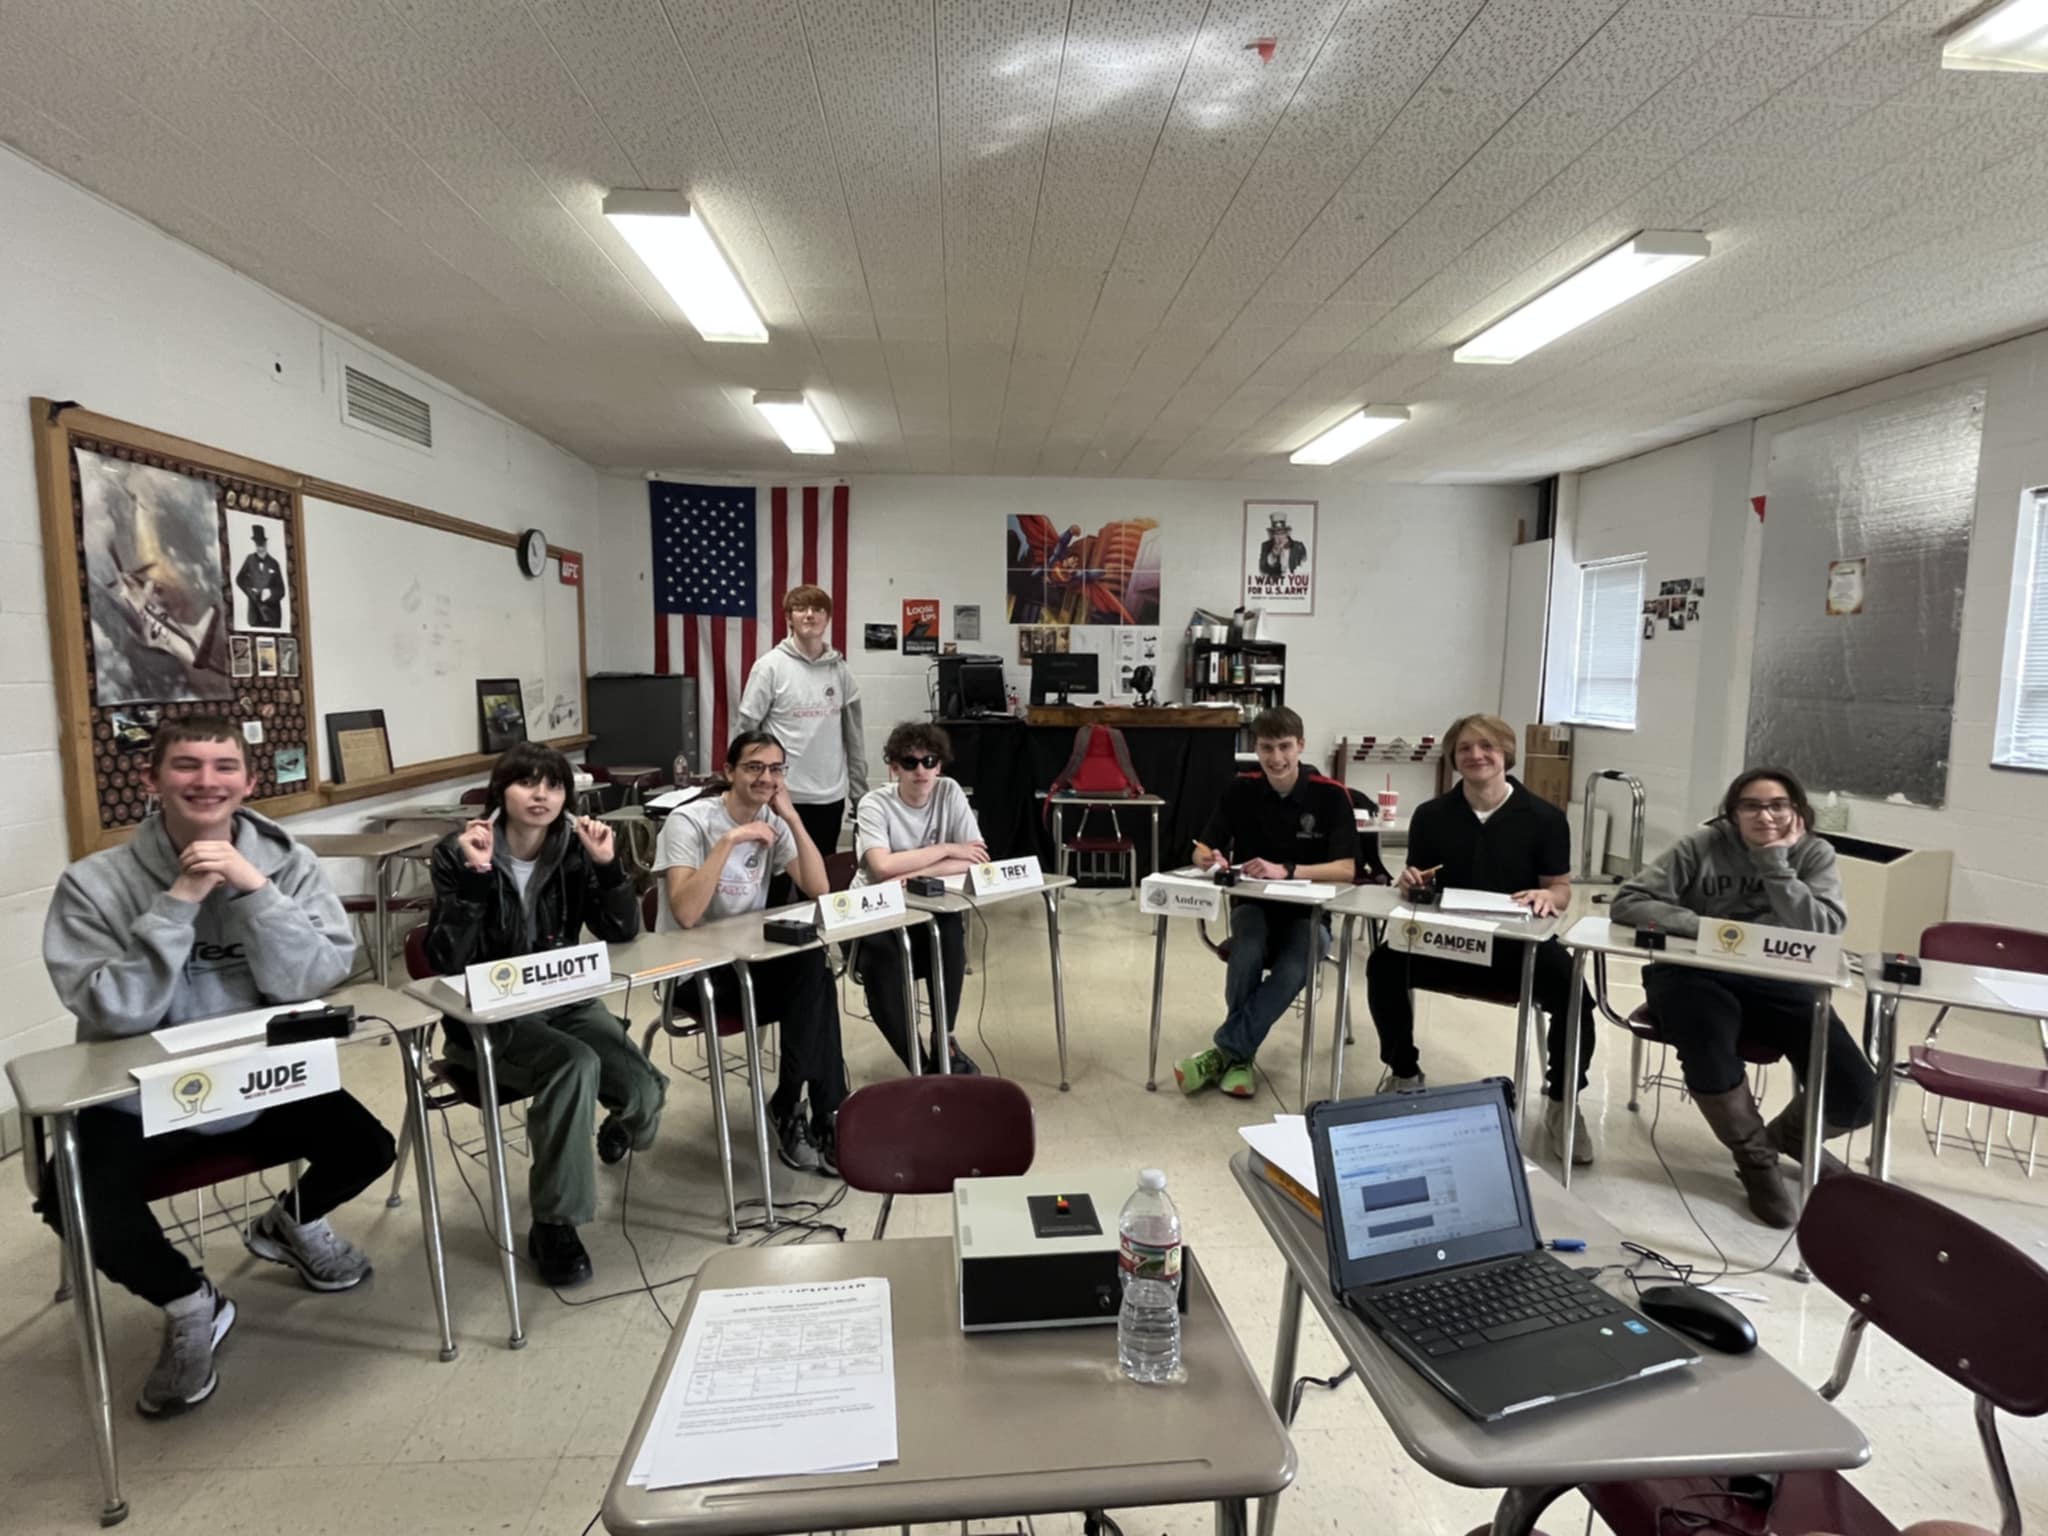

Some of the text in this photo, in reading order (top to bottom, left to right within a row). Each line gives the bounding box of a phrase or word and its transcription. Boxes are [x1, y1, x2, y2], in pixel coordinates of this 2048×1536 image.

[1247, 575, 1309, 586] I WANT YOU
[1247, 587, 1262, 595] FOR
[1285, 587, 1308, 595] ARMY
[906, 605, 934, 616] LOOSE
[1000, 865, 1027, 877] TREY
[861, 895, 873, 908] A.
[877, 893, 888, 906] J.
[1175, 894, 1213, 907] Andrew
[1423, 931, 1487, 954] CAMDEN
[1762, 938, 1816, 959] LUCY
[522, 953, 599, 985] ELLIOTT
[239, 1061, 307, 1094] JUDE
